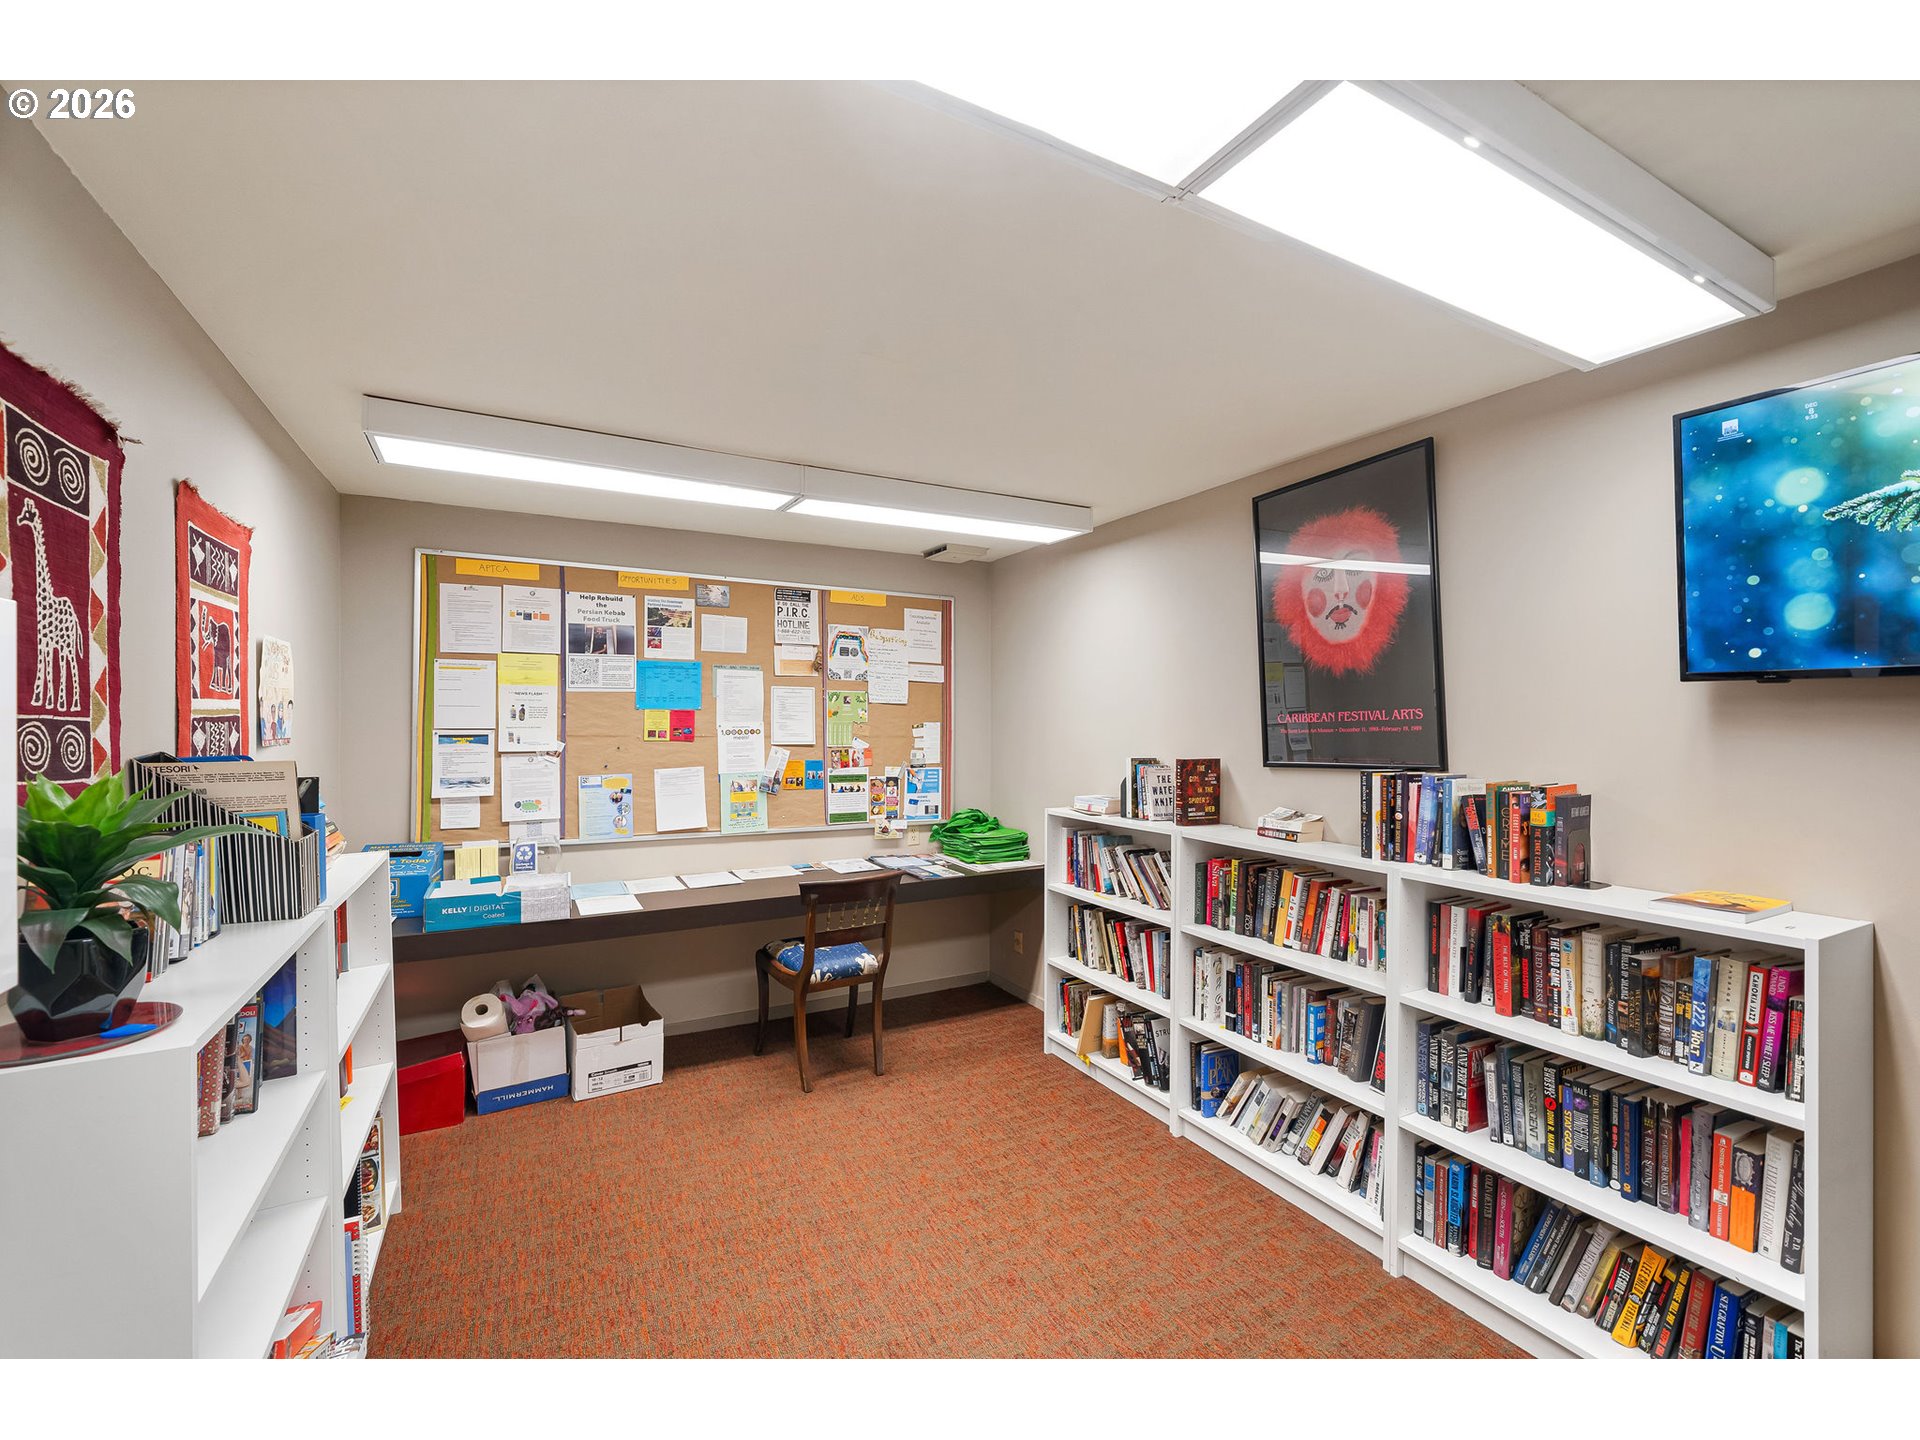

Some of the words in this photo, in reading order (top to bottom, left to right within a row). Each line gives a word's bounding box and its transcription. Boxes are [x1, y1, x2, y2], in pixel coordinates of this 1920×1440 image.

[620, 574, 678, 585] OPPORTUNITIES
[579, 594, 596, 602] Help
[777, 606, 810, 618] P.I.R.C.
[776, 620, 811, 630] HOTLINE
[1277, 711, 1335, 724] CARIBBEAN
[1338, 709, 1390, 722] FESTIVAL
[1391, 708, 1424, 720] ARTS
[152, 765, 191, 774] TESORI
[1157, 775, 1172, 784] THE
[1152, 785, 1175, 795] WATE
[1154, 797, 1173, 807] KNIF
[1204, 805, 1216, 813] WEB
[1501, 807, 1510, 861] CRIME
[1271, 869, 1279, 909] aftermath
[441, 906, 467, 915] KELLY
[473, 903, 505, 912] DIGITAL
[483, 912, 505, 920] Coated
[1550, 937, 1559, 951] THE
[1535, 951, 1544, 967] RED
[1551, 952, 1560, 967] GOD
[1551, 968, 1561, 988] GAME
[1769, 969, 1779, 996] HOWARD
[1778, 975, 1786, 993] LINDA
[1749, 974, 1759, 1004] CAHOKIA
[1693, 1001, 1705, 1027] 1222
[1748, 1005, 1757, 1022] JAZZ
[1768, 1011, 1777, 1024] KISS
[1767, 1025, 1776, 1034] ME
[1691, 1030, 1700, 1056] HOLT
[1764, 1036, 1774, 1055] WHILE
[1457, 1049, 1467, 1067] ANNE
[1457, 1066, 1467, 1086] PERRY
[1762, 1060, 1771, 1077] SLEEP
[1543, 1067, 1551, 1095] GHOSTS
[493, 1085, 554, 1101] HAMMERMILL
[1572, 1085, 1588, 1097] HALE
[1528, 1082, 1538, 1141] INSURGENT
[1546, 1109, 1554, 1125] JOHN
[1564, 1110, 1572, 1129] STAY
[1573, 1111, 1588, 1153] DANGEROUS
[1564, 1130, 1572, 1155] GOLD
[1645, 1137, 1653, 1157] REBEL
[1451, 1172, 1459, 1189] KARIN
[1642, 1159, 1654, 1188] SPRING
[1484, 1174, 1493, 1192] COLIN
[1765, 1164, 1778, 1211] ELIZABETH
[1450, 1190, 1460, 1223] SLAUGHTER
[1483, 1193, 1493, 1218] DEXTER
[1762, 1212, 1774, 1244] GEORGE
[1784, 1230, 1792, 1248] James
[1792, 1237, 1801, 1251] P.D.
[1576, 1249, 1597, 1281] MEASURE
[1673, 1282, 1686, 1303] HOUSE
[1720, 1294, 1729, 1310] SUE
[1621, 1303, 1637, 1332] PERSONAL
[1714, 1309, 1727, 1346] GRAFTON
[1659, 1327, 1671, 1347] STEPH
[1794, 1339, 1802, 1352] The
[1655, 1344, 1665, 1357] CHA
